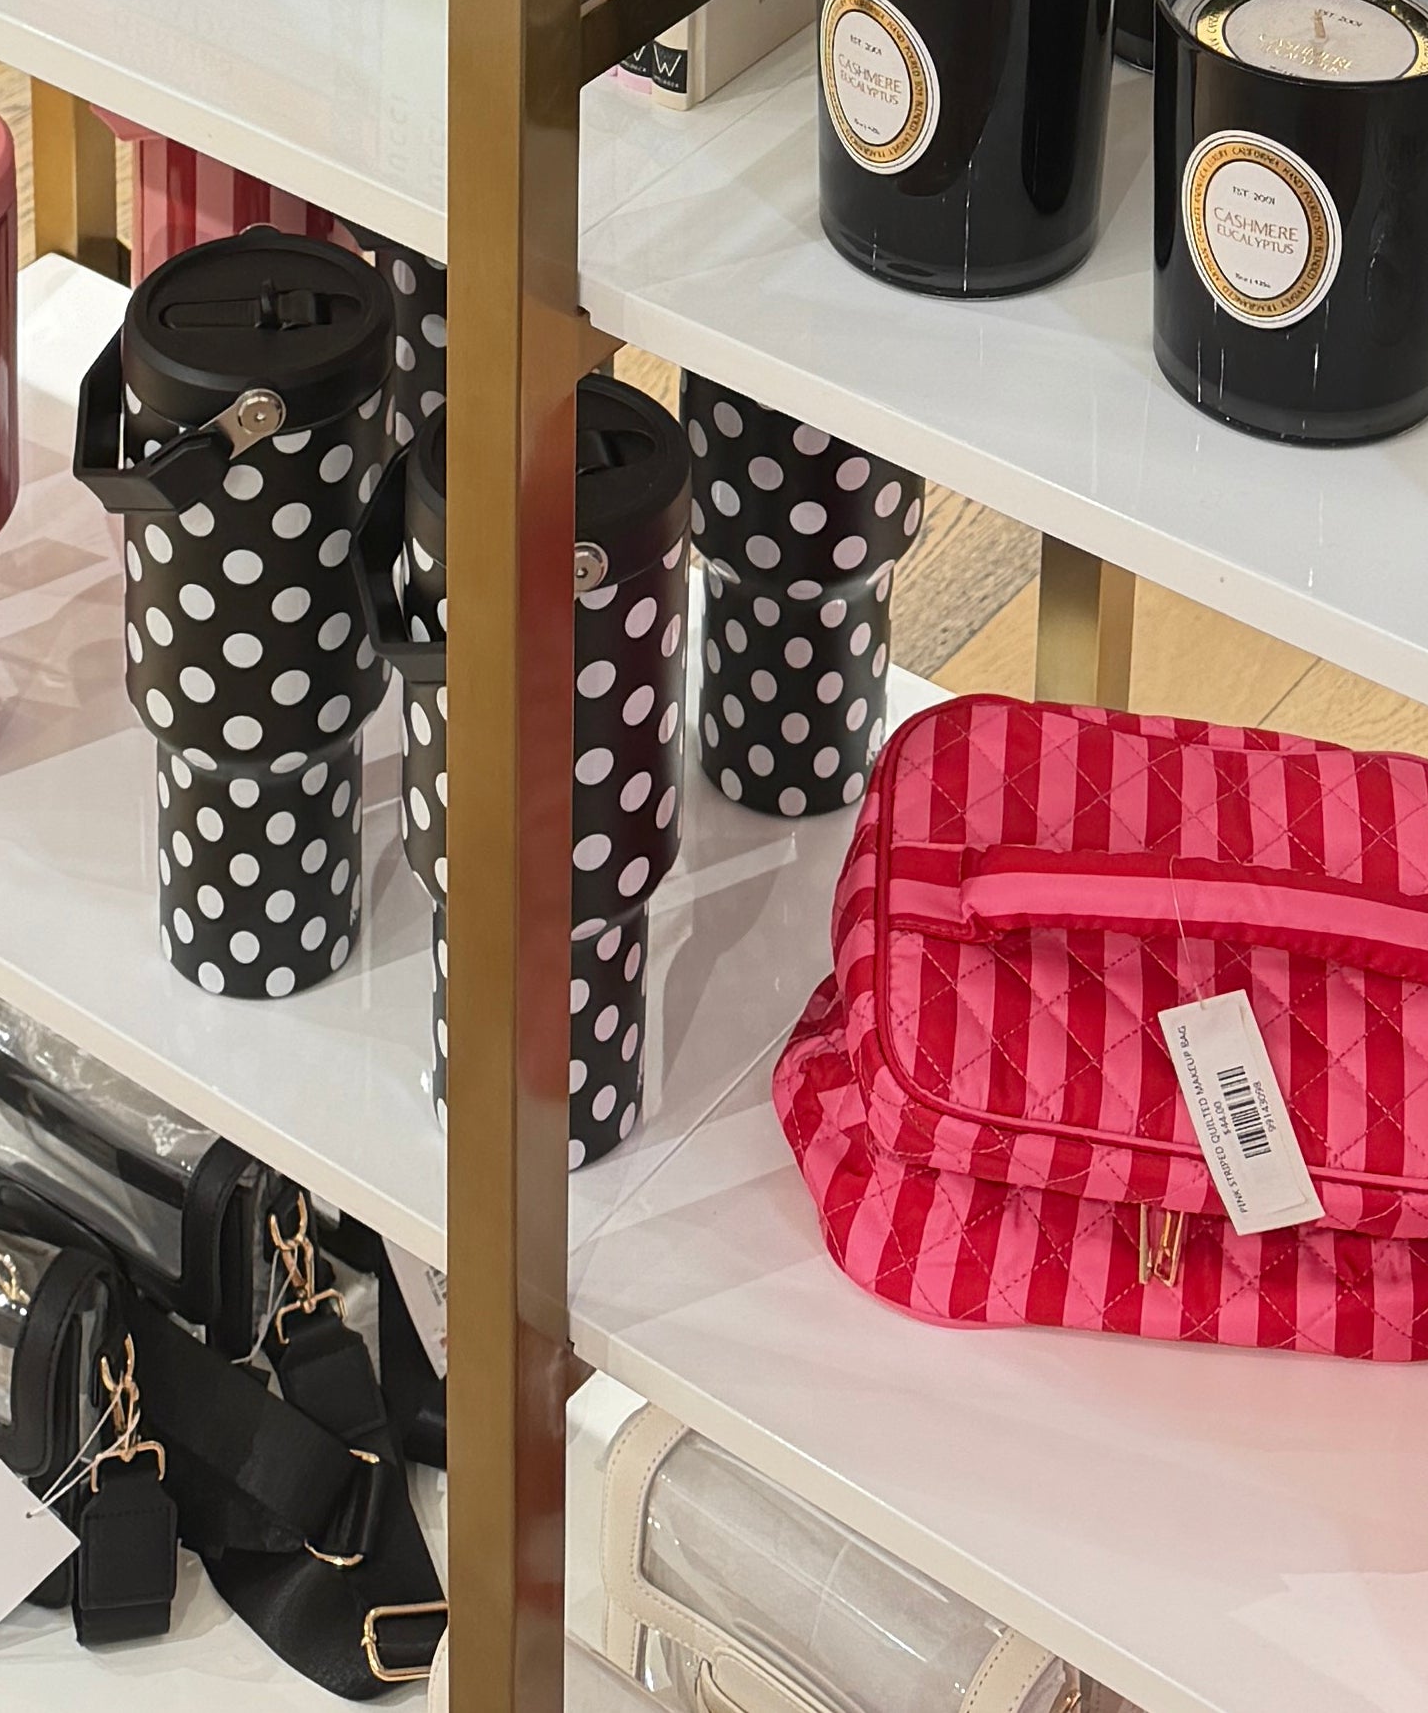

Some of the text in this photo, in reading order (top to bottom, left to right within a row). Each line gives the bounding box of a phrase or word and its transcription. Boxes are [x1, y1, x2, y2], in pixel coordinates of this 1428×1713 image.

[653, 43, 682, 77] W
[837, 53, 903, 95] CASHMERE
[840, 69, 900, 106] EUCALYPTUS
[1231, 146, 1280, 169] CALIFORNIA
[1282, 165, 1304, 190] HAND
[1252, 191, 1276, 206] 2001
[1213, 206, 1299, 243] CASHMERE
[1216, 224, 1295, 256] EUCALYPTUS
[1177, 1024, 1249, 1215] PINK STRIPED QUILTED MAKEUP BAG
[1213, 1100, 1232, 1137] $44.00
